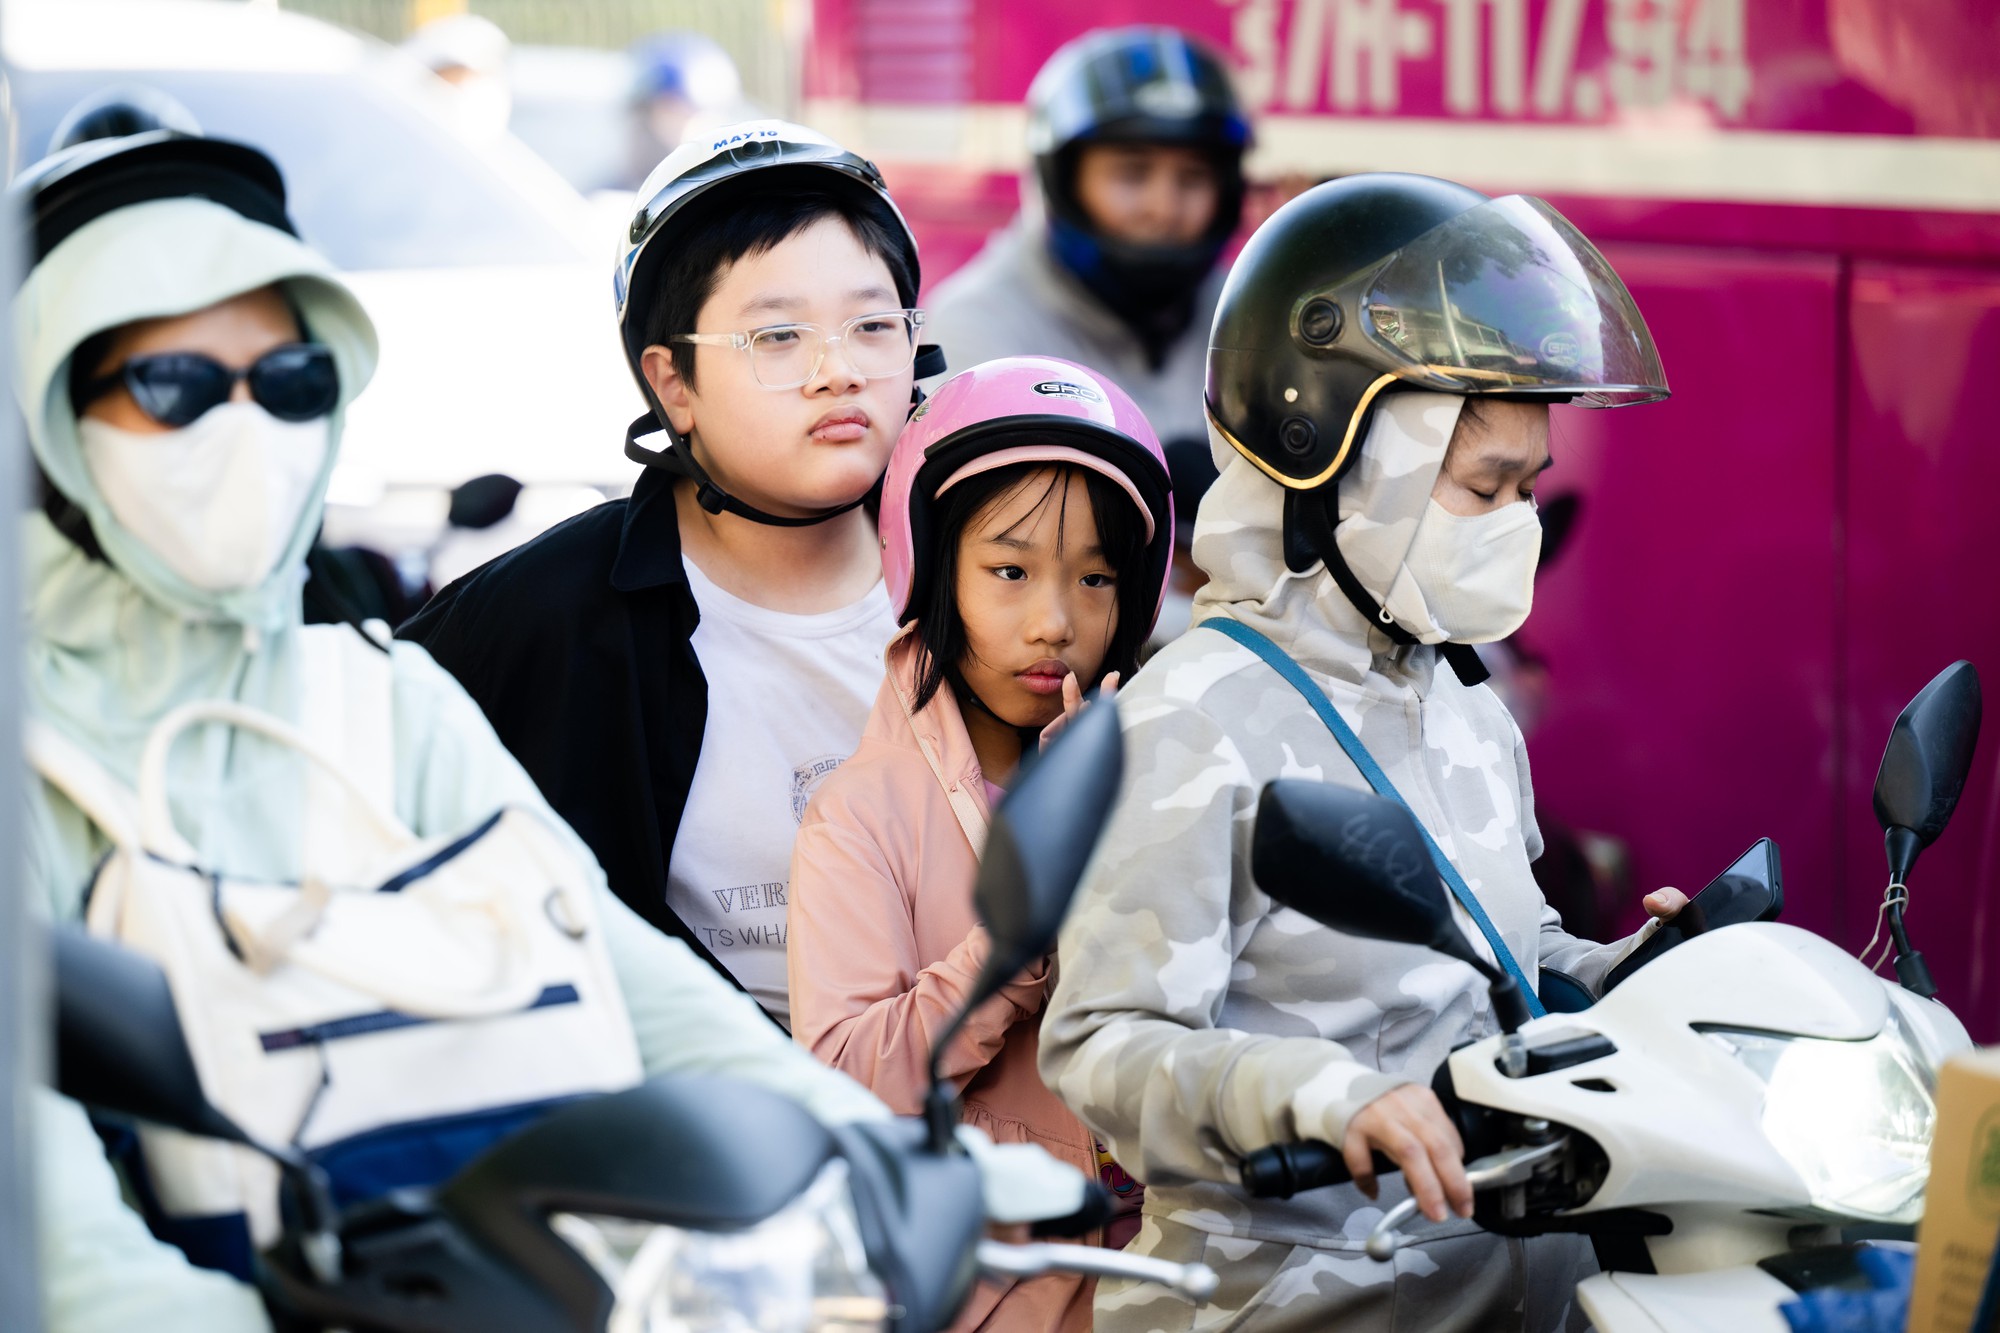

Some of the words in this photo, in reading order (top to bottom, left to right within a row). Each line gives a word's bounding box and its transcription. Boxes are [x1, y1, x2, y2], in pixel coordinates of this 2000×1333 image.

[713, 131, 754, 151] MAY
[1041, 383, 1098, 399] GRO
[712, 881, 790, 914] VER
